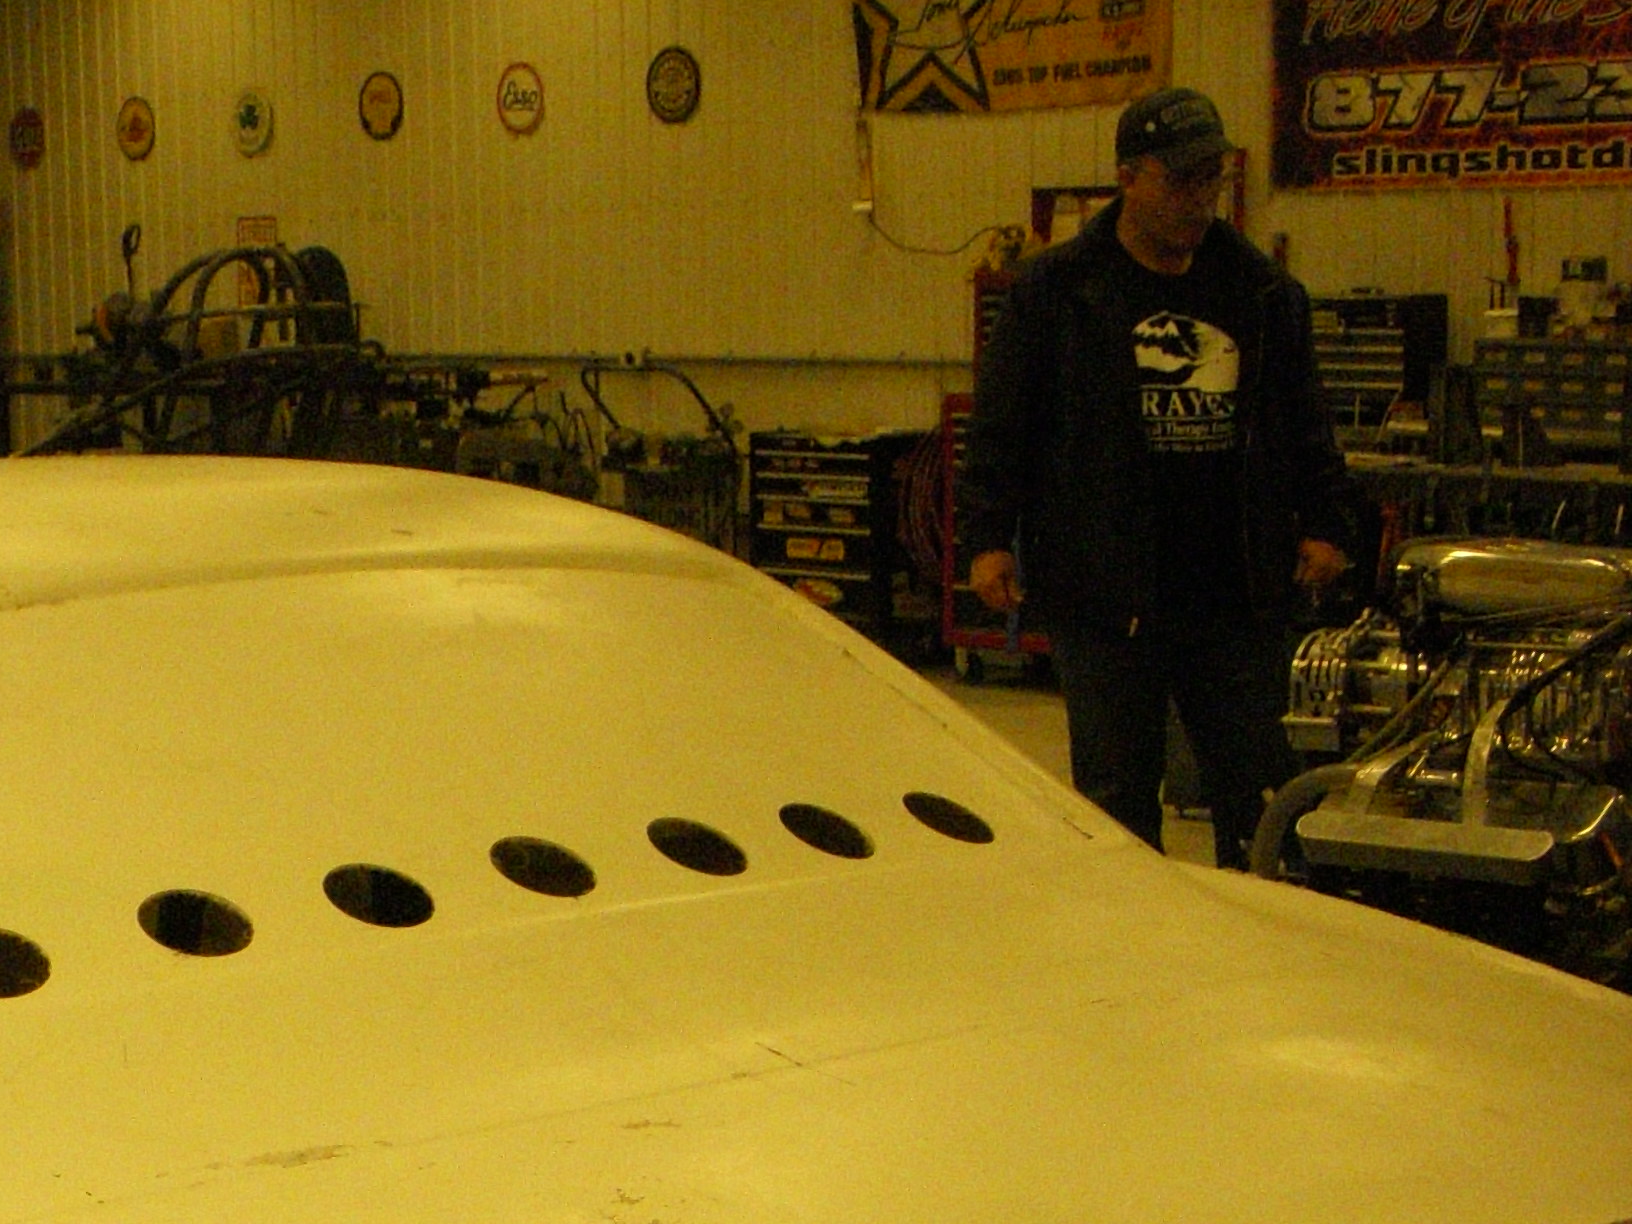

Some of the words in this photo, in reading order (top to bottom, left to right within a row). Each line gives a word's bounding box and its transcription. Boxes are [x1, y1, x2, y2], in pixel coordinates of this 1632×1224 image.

[1053, 62, 1082, 82] FUEL
[503, 80, 539, 112] Esso
[1332, 139, 1632, 178] slingshotd
